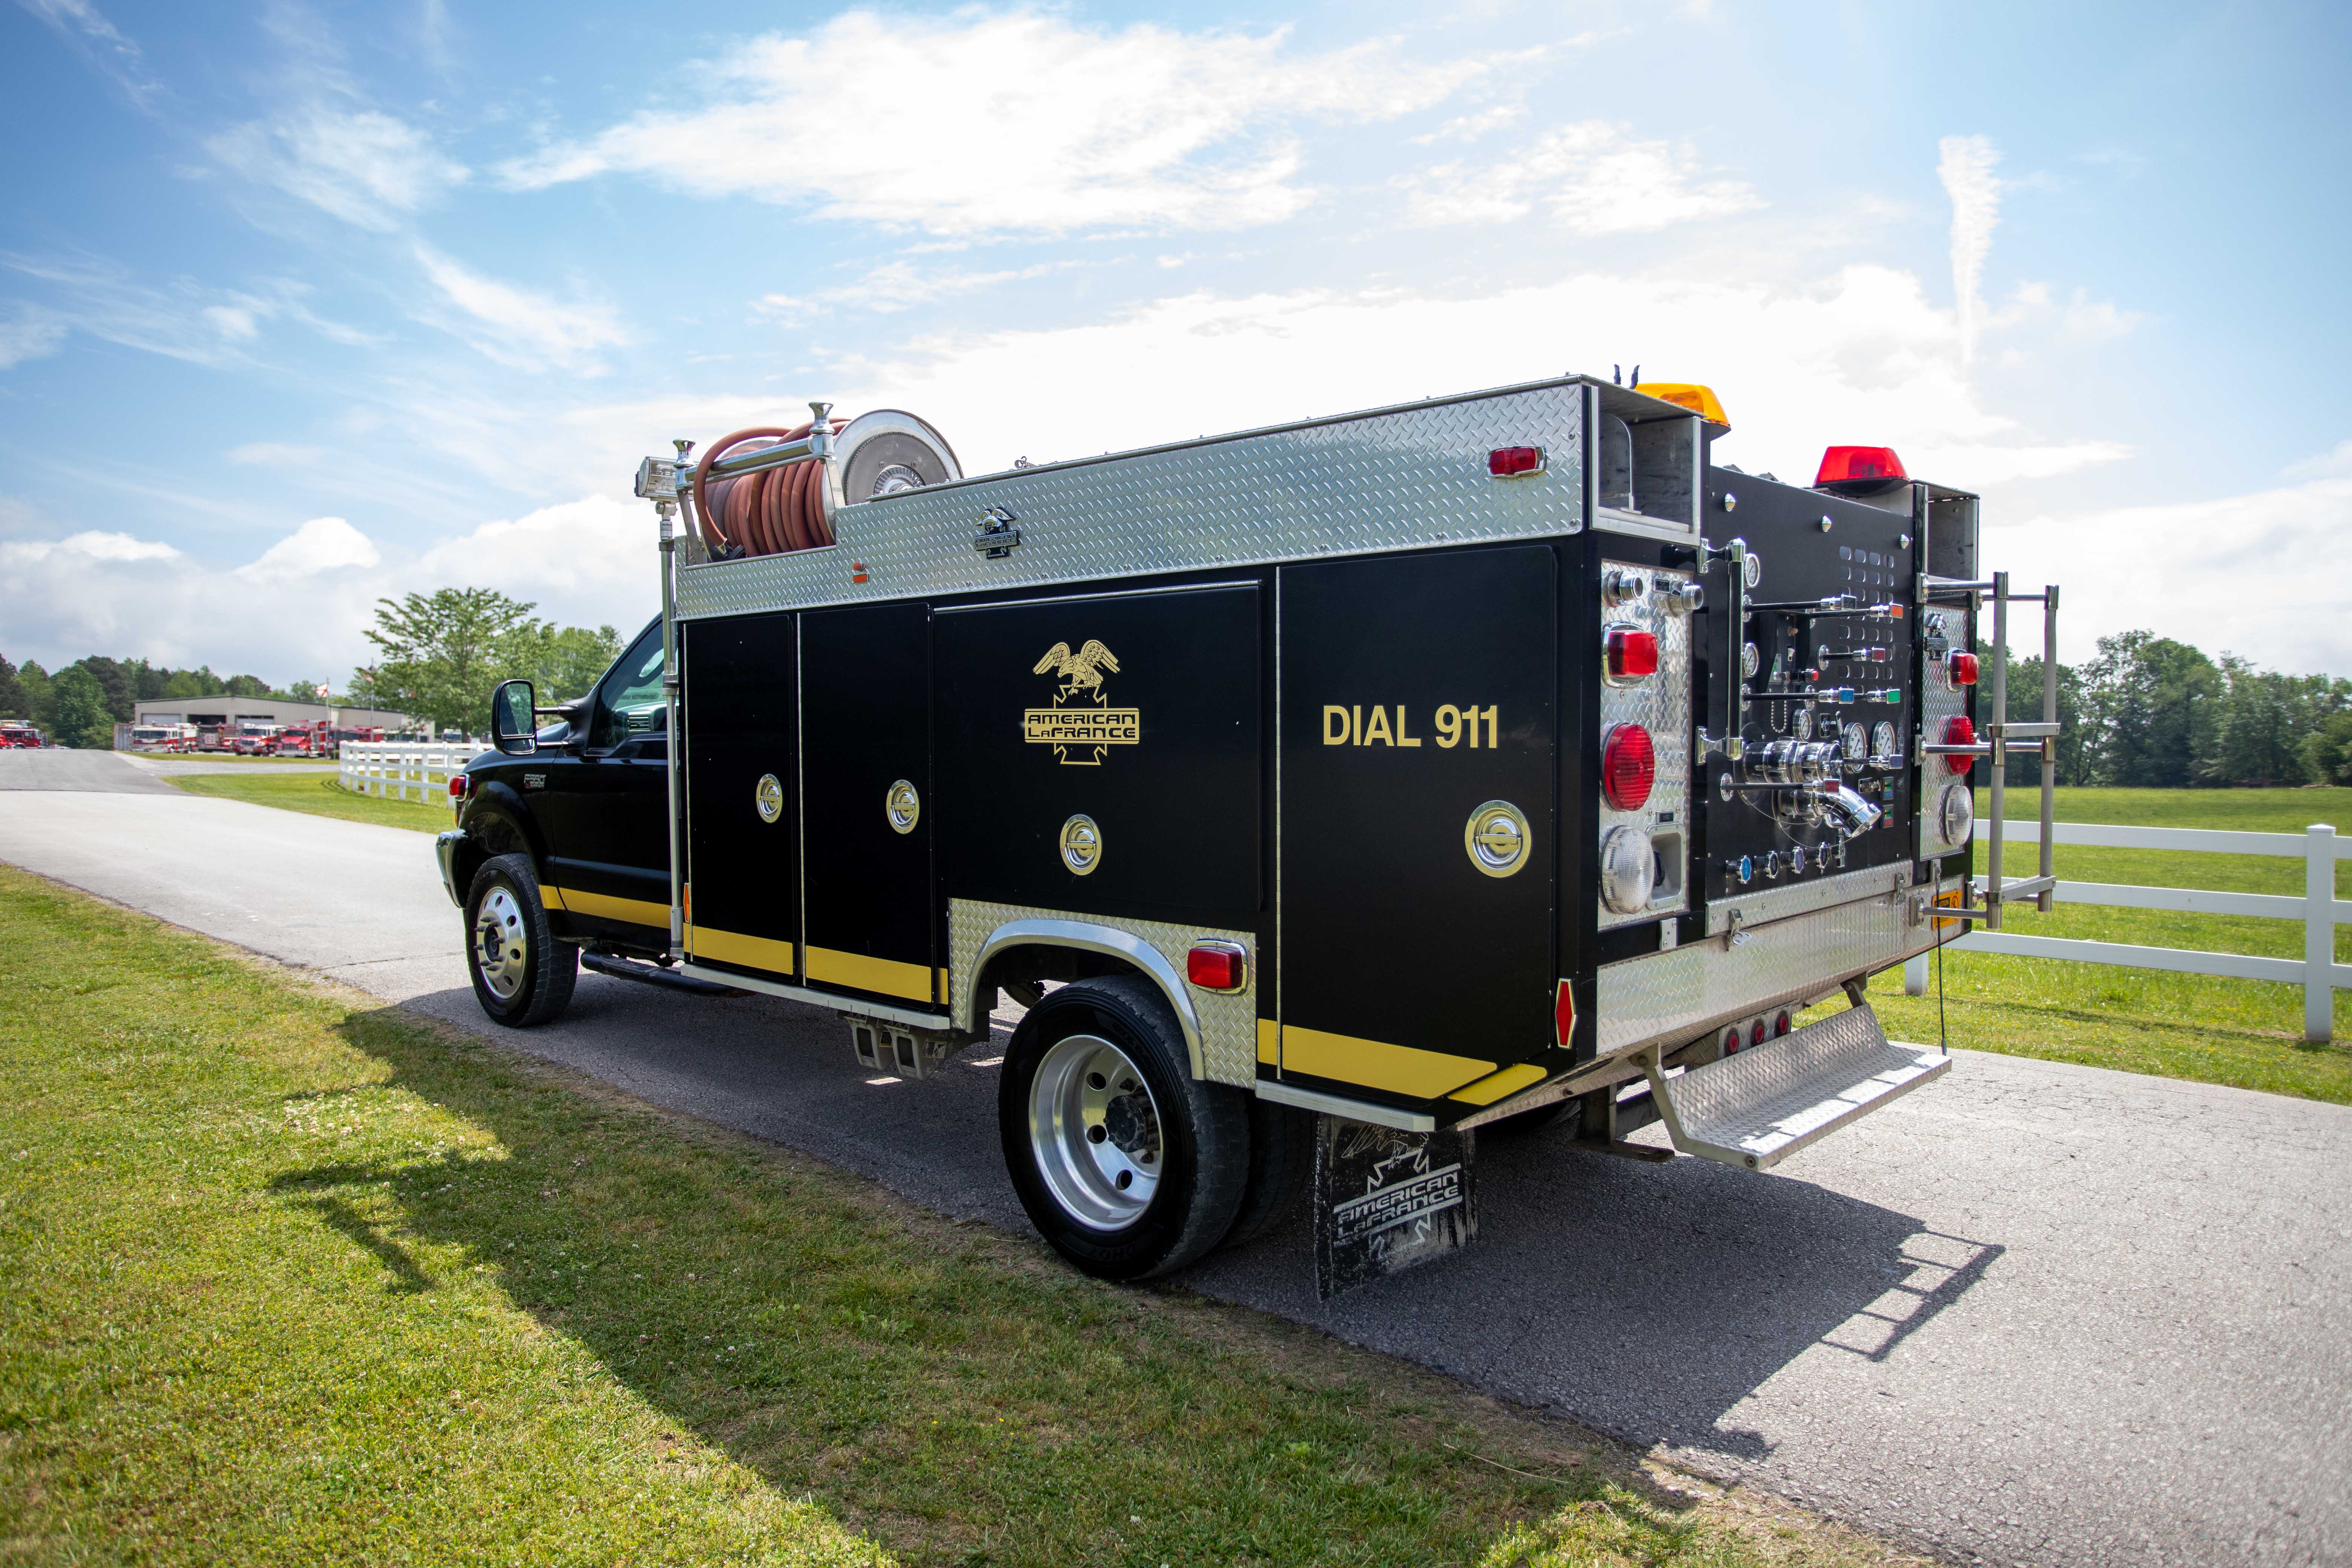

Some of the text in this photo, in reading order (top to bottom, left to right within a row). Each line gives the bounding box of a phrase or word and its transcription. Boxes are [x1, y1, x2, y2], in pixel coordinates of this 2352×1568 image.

[976, 534, 1015, 543] AMERICAN
[1028, 714, 1136, 724] AMERICAN
[1323, 704, 1497, 748] DIAL 911
[1338, 1171, 1458, 1225] AMERICAN
